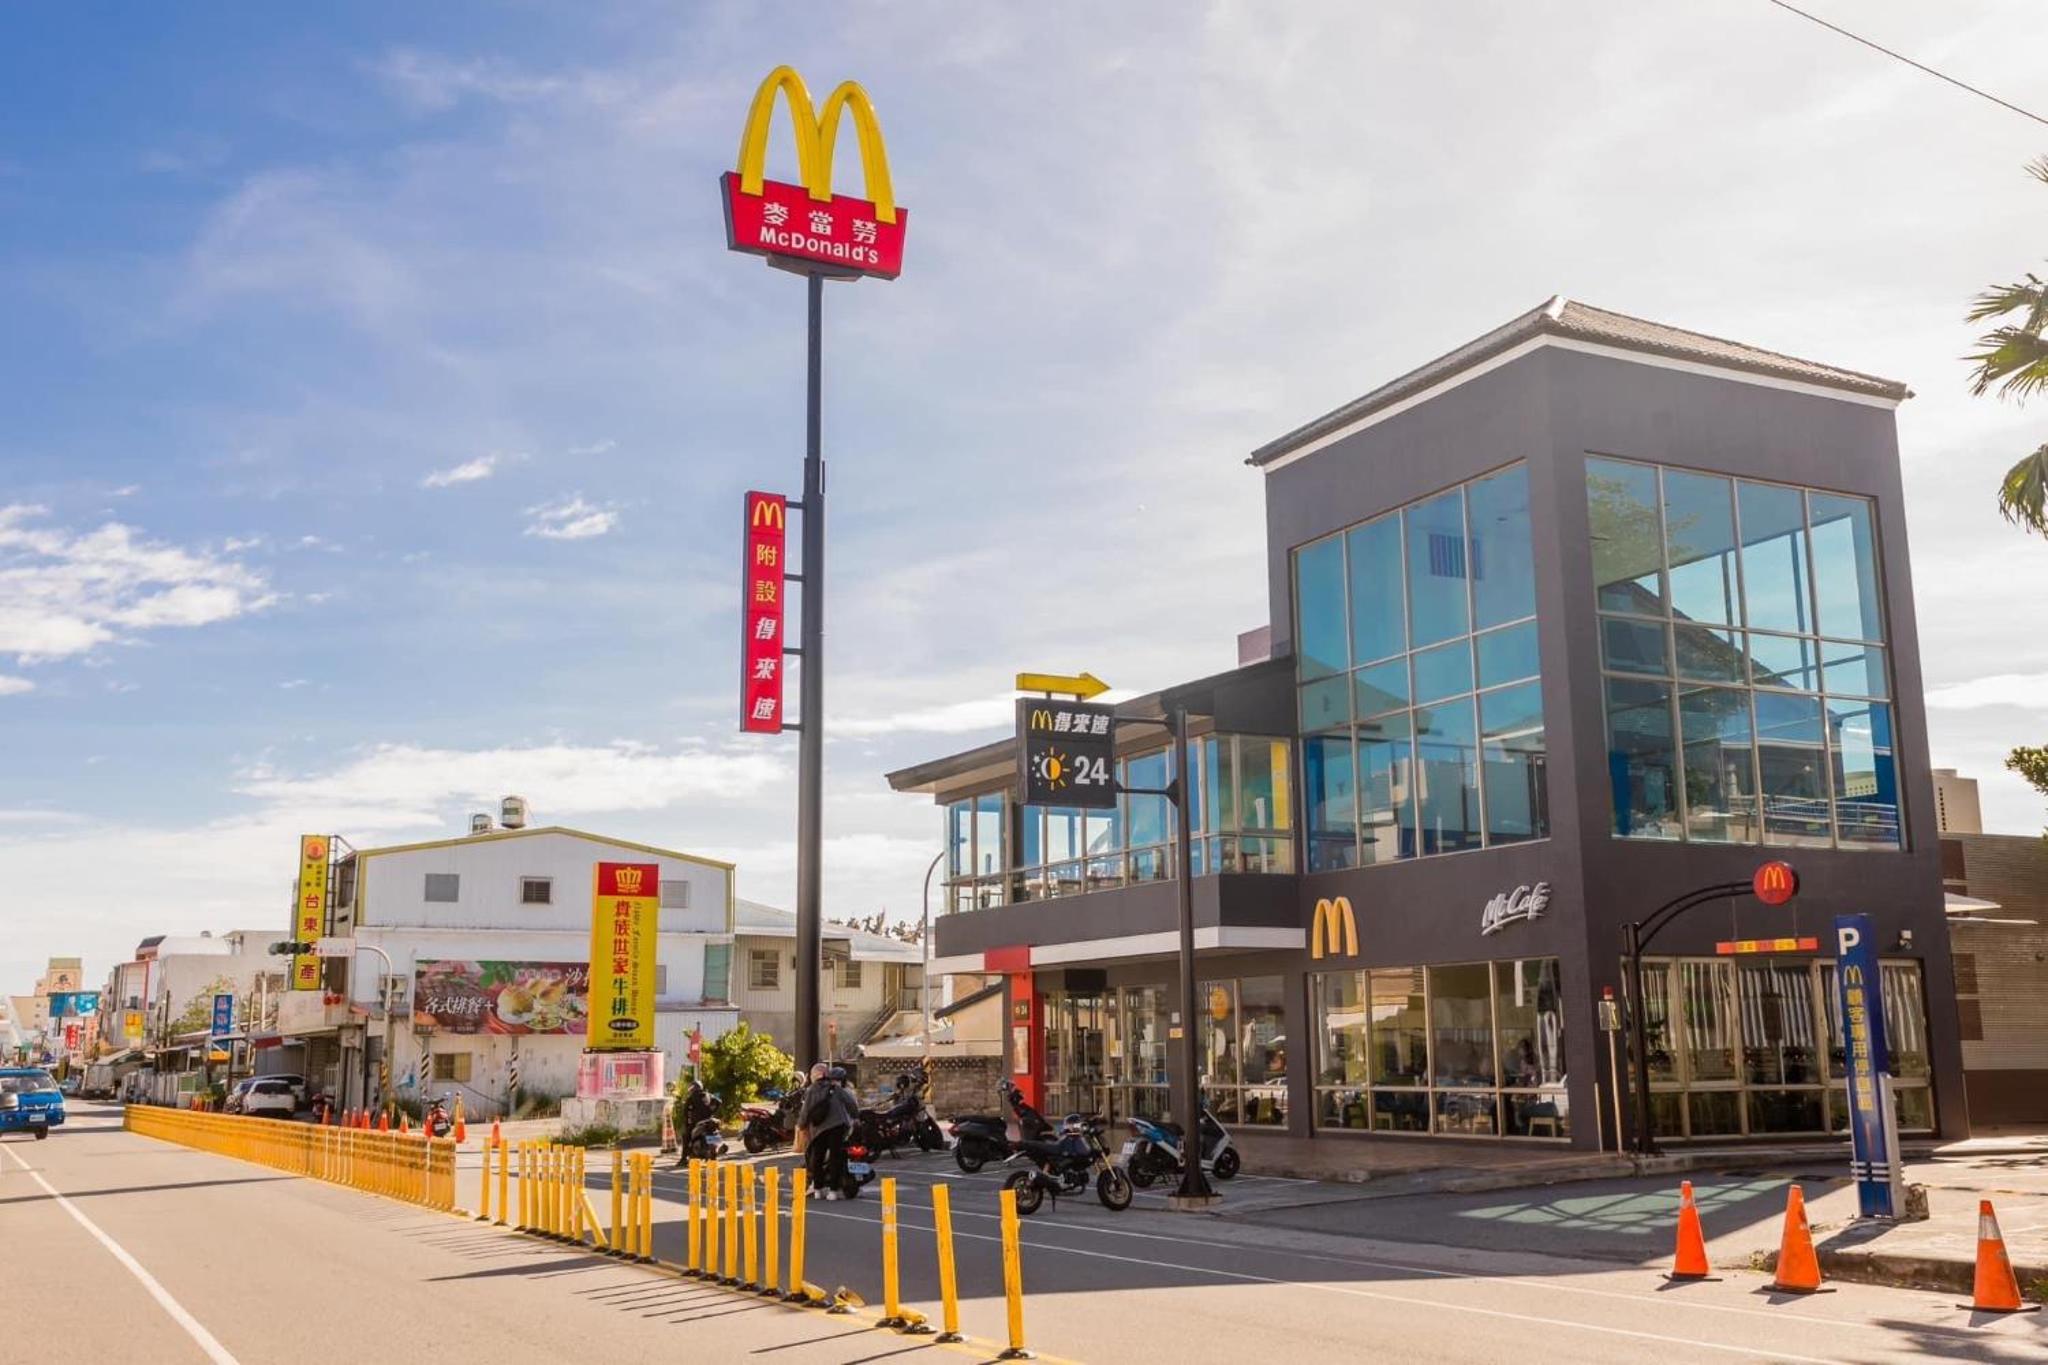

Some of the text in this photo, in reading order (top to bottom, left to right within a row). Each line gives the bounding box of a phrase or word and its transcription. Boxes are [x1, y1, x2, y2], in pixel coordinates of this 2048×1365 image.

[763, 202, 877, 244] 麥當勞
[759, 226, 879, 264] McDonald's
[1054, 711, 1110, 735] 得來速
[1074, 755, 1109, 786] 24
[1837, 927, 1860, 955] P
